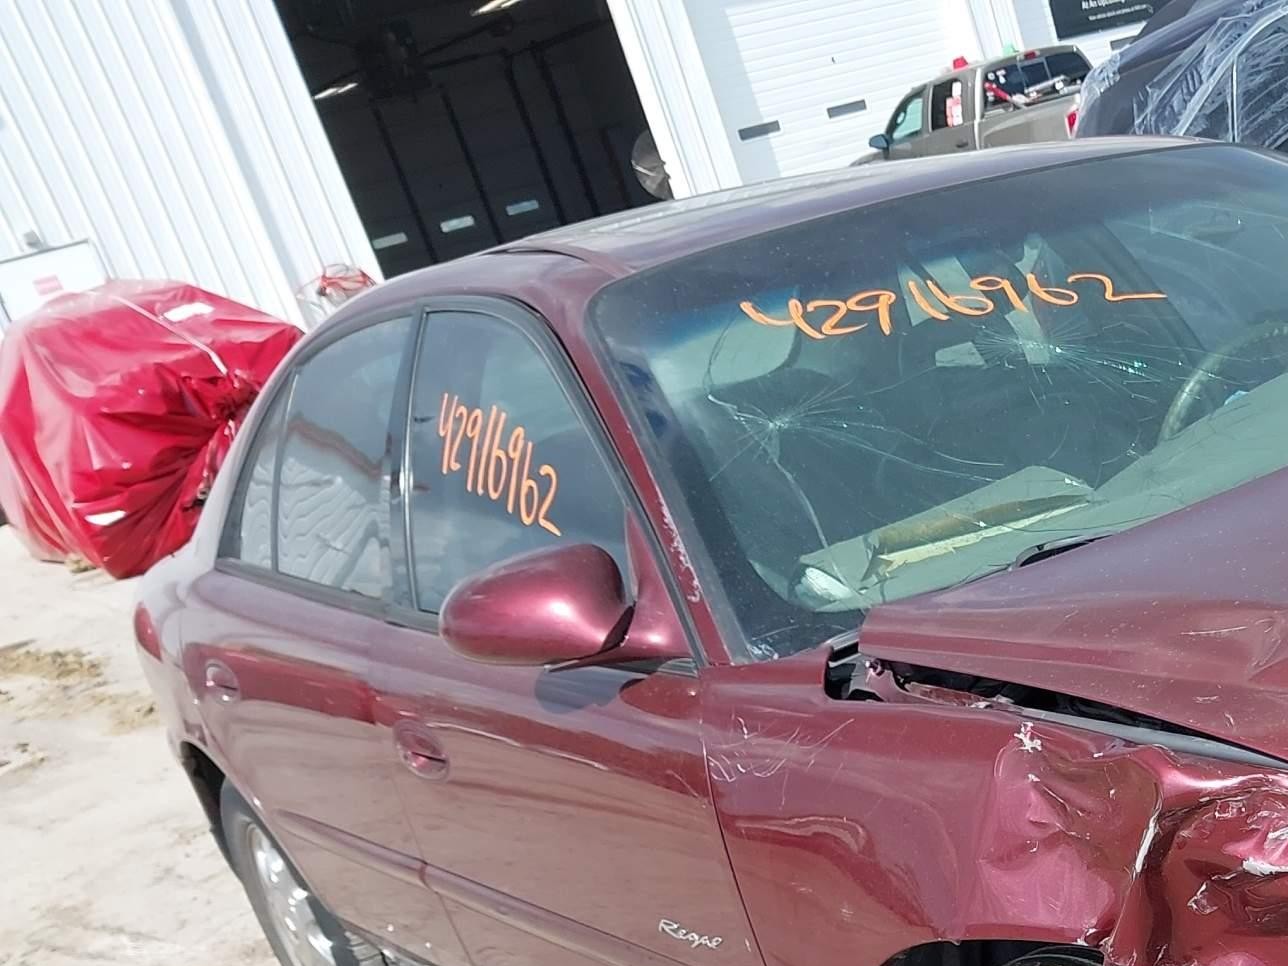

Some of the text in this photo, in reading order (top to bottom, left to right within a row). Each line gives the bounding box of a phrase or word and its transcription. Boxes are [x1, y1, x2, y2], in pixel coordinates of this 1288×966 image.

[739, 274, 1168, 339] 42916962
[439, 392, 562, 537] 42916962
[658, 918, 723, 949] Regal
